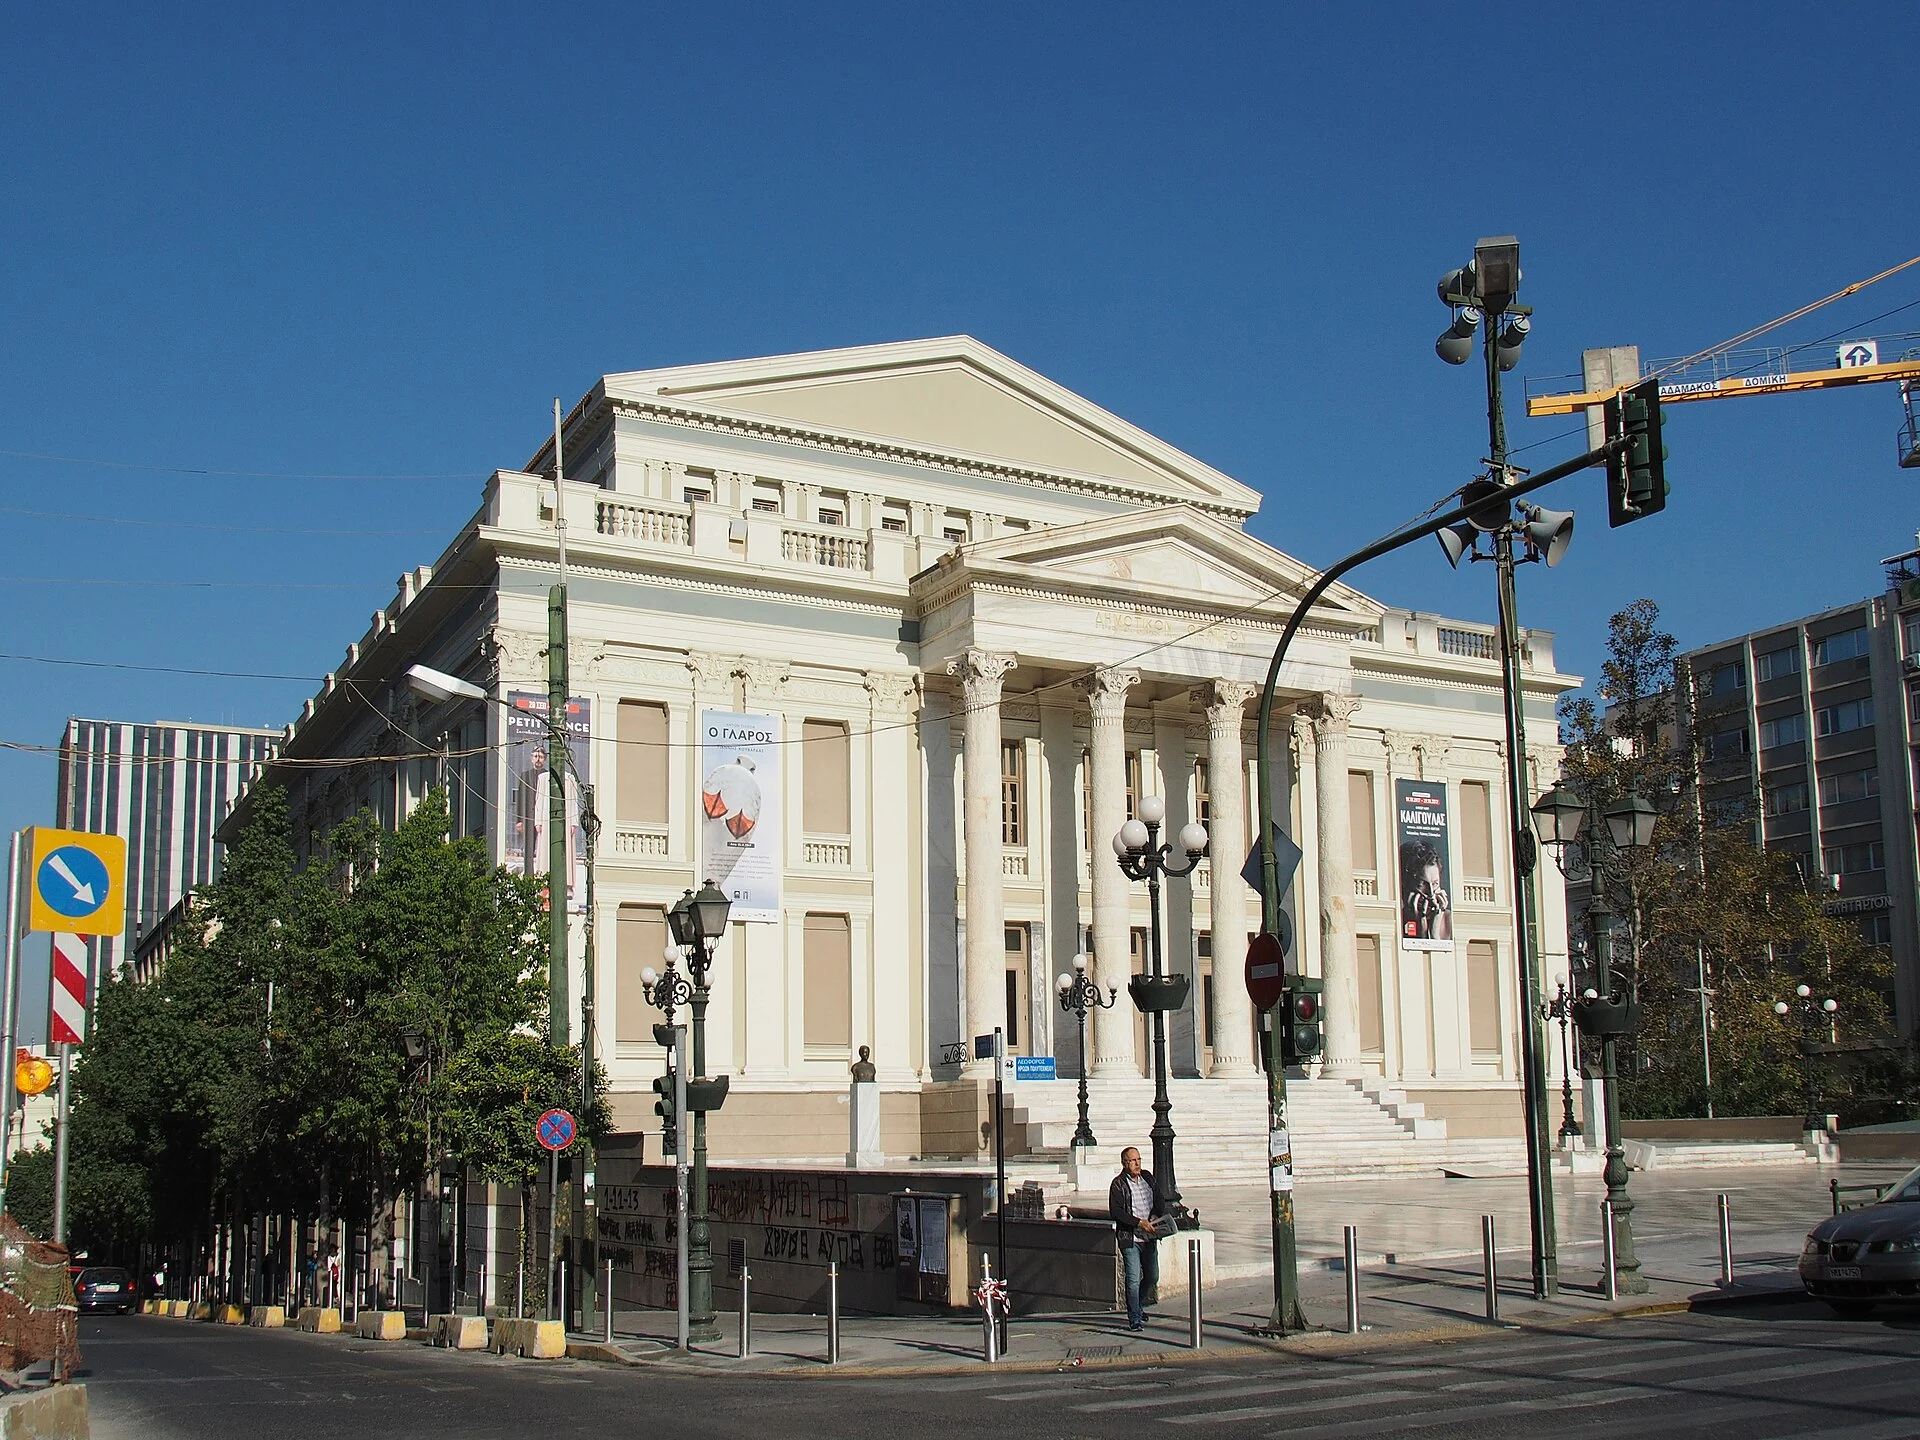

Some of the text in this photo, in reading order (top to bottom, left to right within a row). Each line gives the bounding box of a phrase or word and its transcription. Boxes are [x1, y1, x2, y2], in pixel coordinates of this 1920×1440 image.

[1660, 375, 1786, 395] ΑΔΑΜΑΚΟΣ ΔΟΜΙΚΗ
[508, 716, 541, 729] PETIT
[708, 726, 773, 743] Ο ΓΛΑΡΟΣ
[1400, 809, 1446, 826] ΚΑΛΙΓΟΥΛΑΣ
[604, 1186, 640, 1211] 1-11-13
